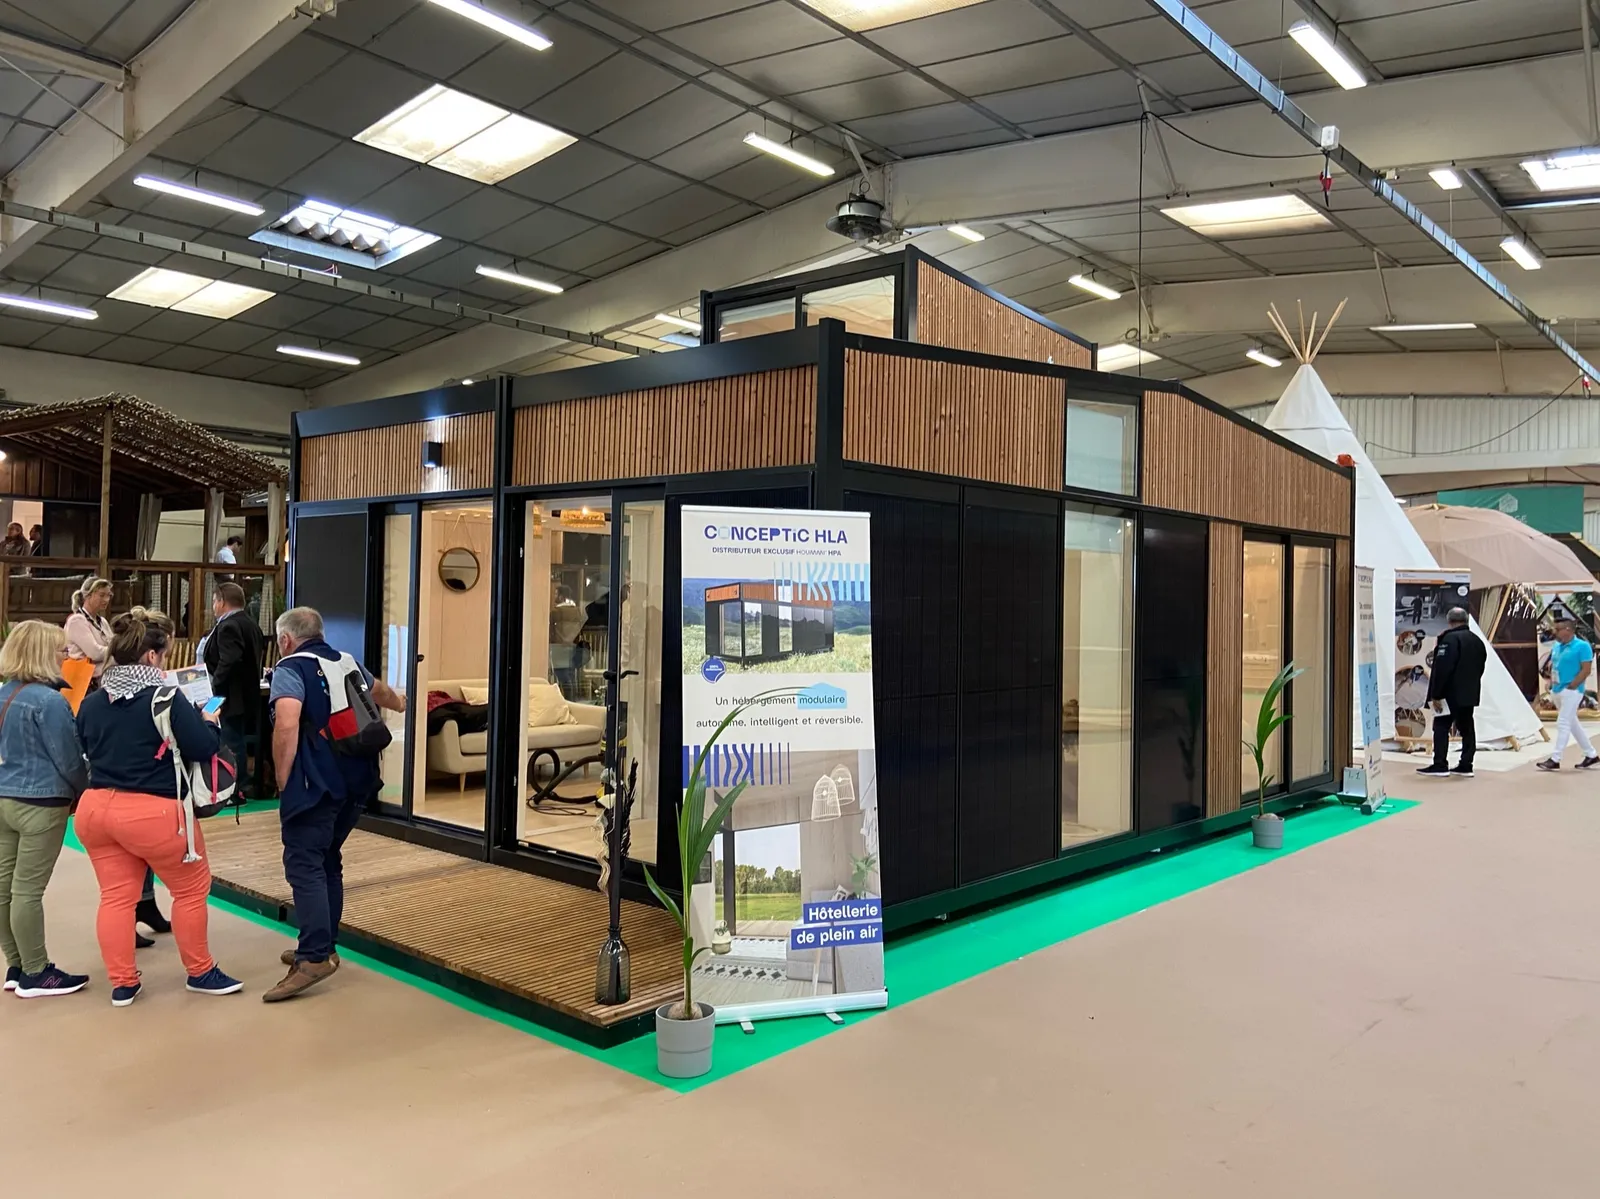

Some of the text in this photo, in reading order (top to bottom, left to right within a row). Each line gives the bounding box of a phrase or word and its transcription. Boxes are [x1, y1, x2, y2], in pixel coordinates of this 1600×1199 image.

[815, 529, 848, 544] HLA
[712, 546, 761, 554] DISTRIBUTEUR
[763, 547, 795, 555] EXCLUSIF
[715, 696, 729, 706] Un
[799, 694, 845, 705] modulaire
[750, 717, 798, 728] intelligent
[802, 716, 812, 726] et
[808, 903, 878, 921] Hôtellerie
[796, 924, 878, 945] de plein air
